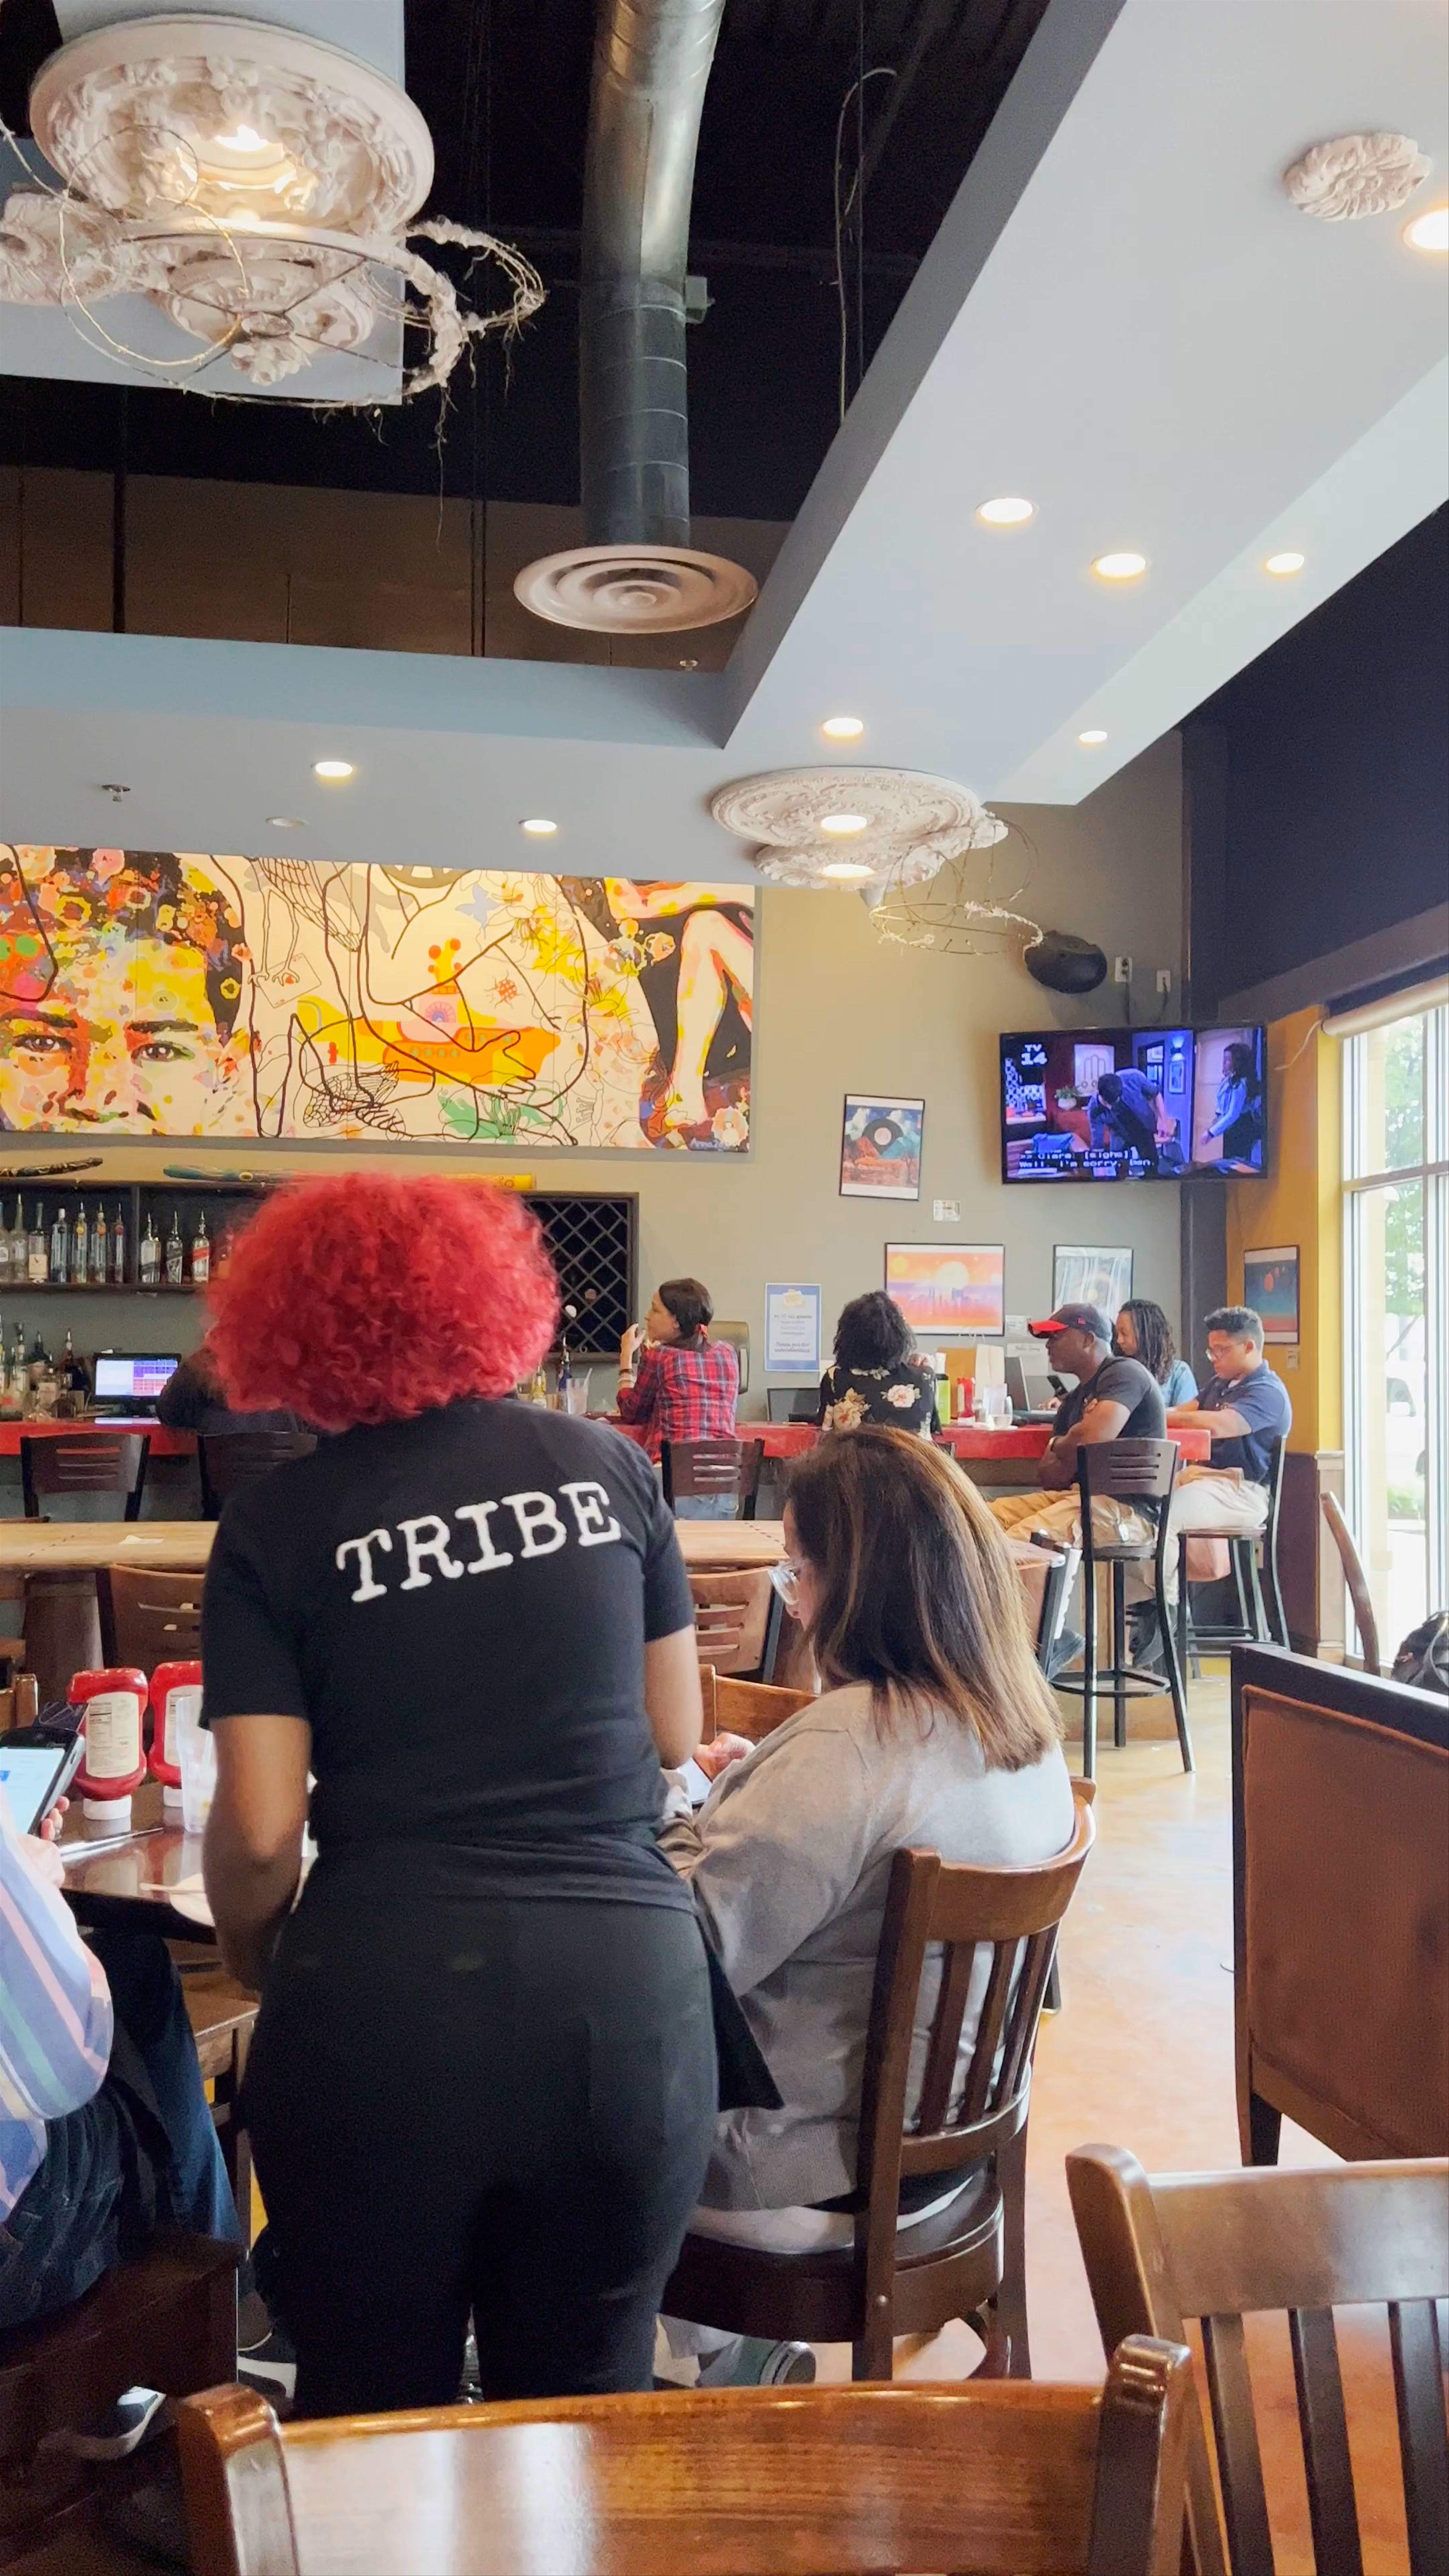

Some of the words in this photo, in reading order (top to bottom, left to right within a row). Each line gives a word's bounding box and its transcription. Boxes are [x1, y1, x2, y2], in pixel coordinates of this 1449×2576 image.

[1024, 1044, 1042, 1052] TV
[1021, 1052, 1048, 1066] 14
[336, 1481, 621, 1603] TRIBE
